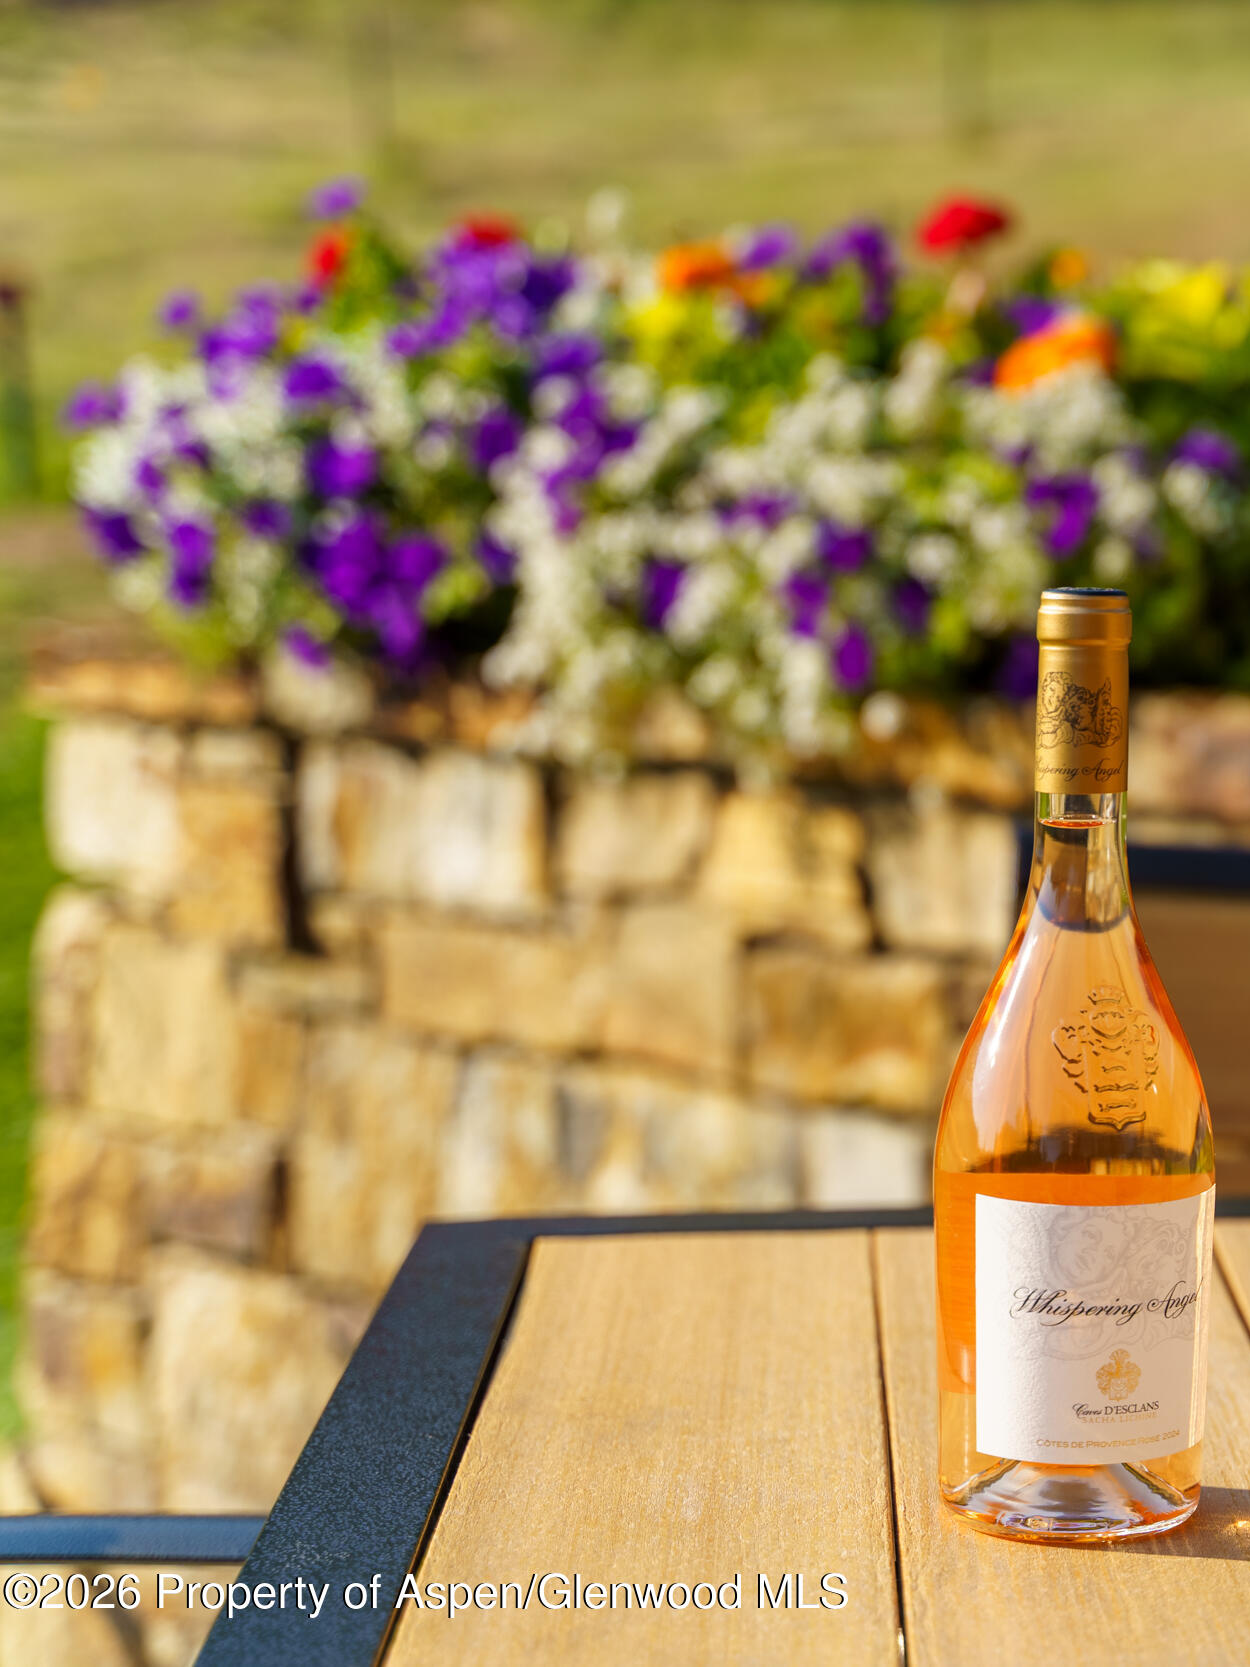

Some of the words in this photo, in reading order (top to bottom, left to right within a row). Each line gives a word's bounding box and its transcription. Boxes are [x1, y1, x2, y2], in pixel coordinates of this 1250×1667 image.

[1081, 757, 1125, 782] Angel
[1009, 1286, 1143, 1327] Whispering
[1146, 1275, 1204, 1319] Angel
[1104, 1400, 1160, 1416] D'ESCLANS
[1070, 1440, 1084, 1449] DE
